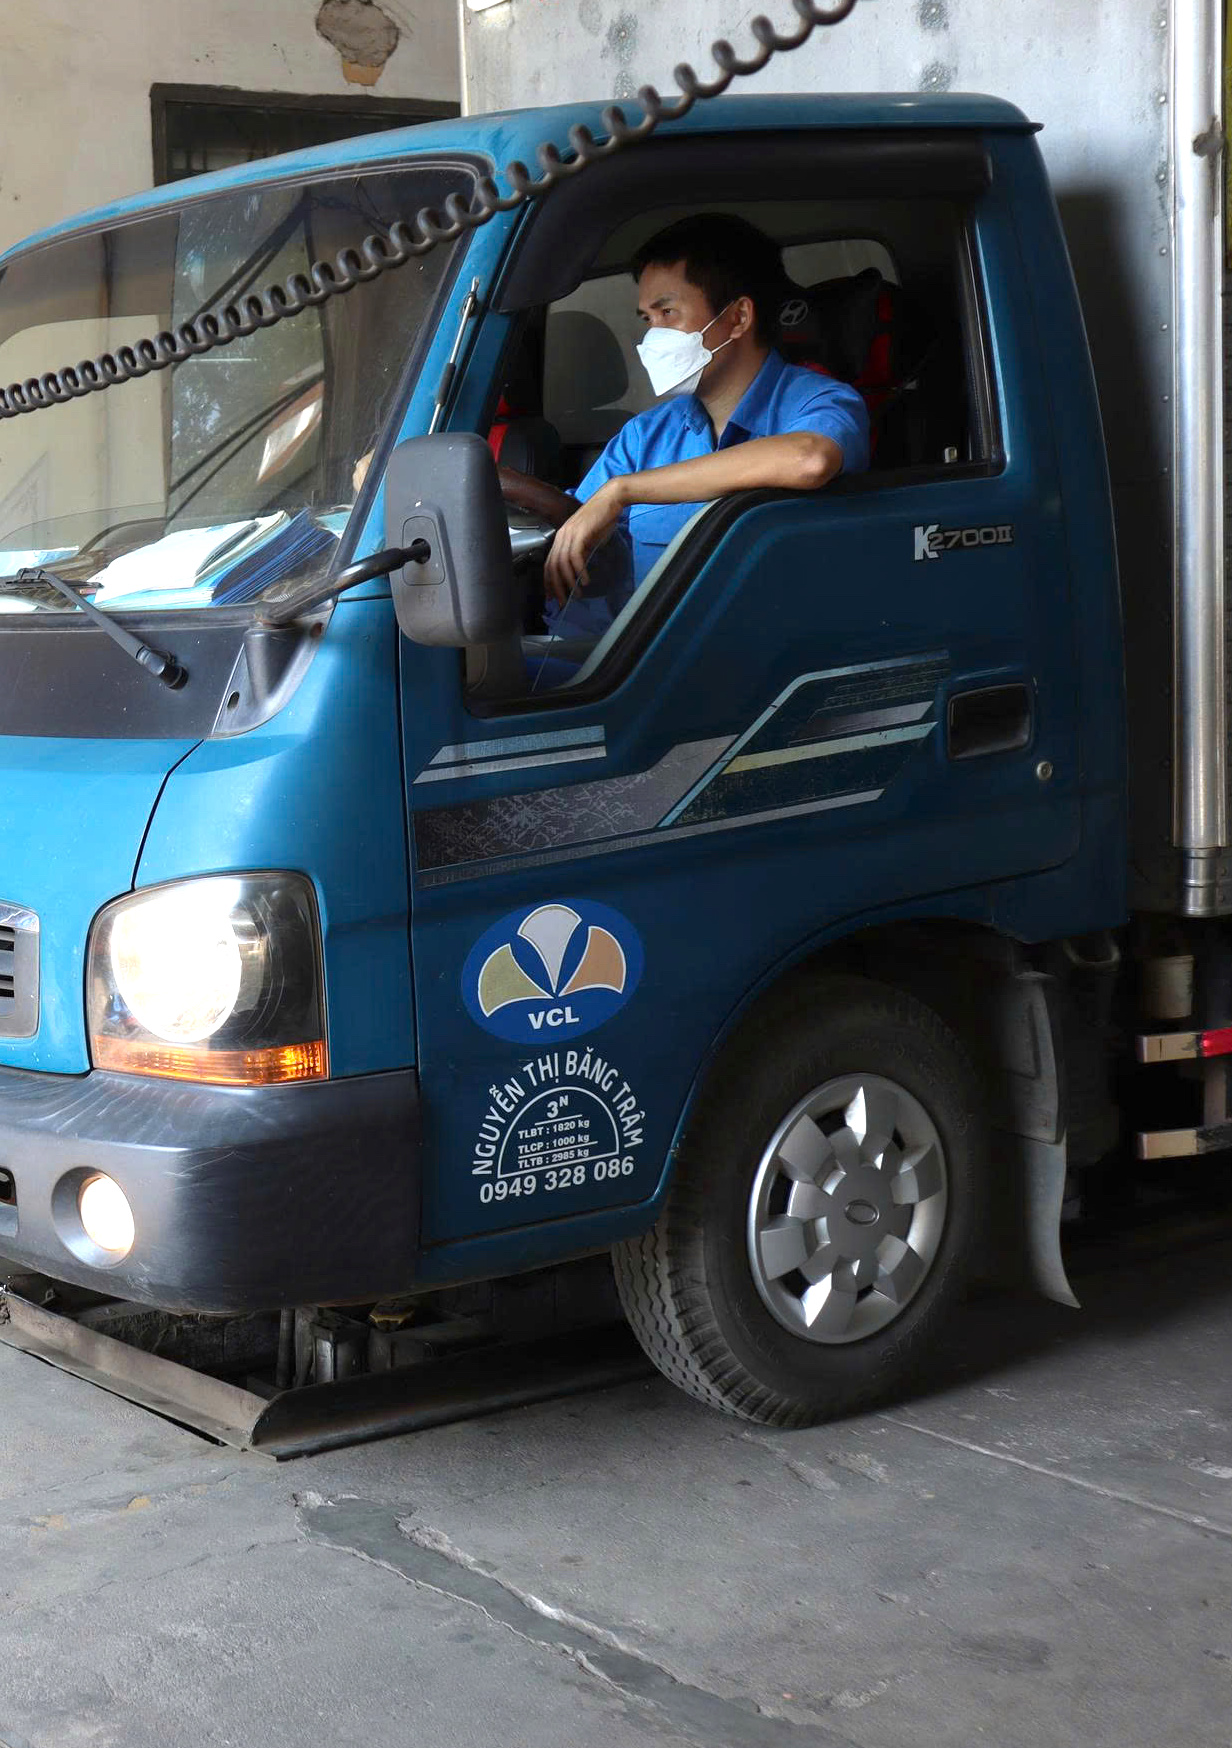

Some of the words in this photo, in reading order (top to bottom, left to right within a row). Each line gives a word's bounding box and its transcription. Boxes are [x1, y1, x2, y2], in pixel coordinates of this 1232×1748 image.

[528, 1006, 579, 1029] VCL
[472, 1077, 526, 1175] NGUYỄN
[522, 1053, 561, 1087] THỊ
[565, 1047, 618, 1089] BĂNG
[612, 1081, 645, 1149] TRÂM
[518, 1126, 544, 1139] TLBT
[552, 1120, 576, 1133] 1820
[578, 1119, 590, 1131] kg
[518, 1142, 544, 1154] TLCP
[552, 1136, 576, 1148] 1000
[578, 1134, 590, 1146] kg
[518, 1156, 543, 1169] TLTB
[551, 1150, 576, 1163] 2985
[577, 1148, 589, 1160] kg
[479, 1178, 537, 1204] 0949
[544, 1166, 586, 1191] 328
[594, 1155, 635, 1183] 086
